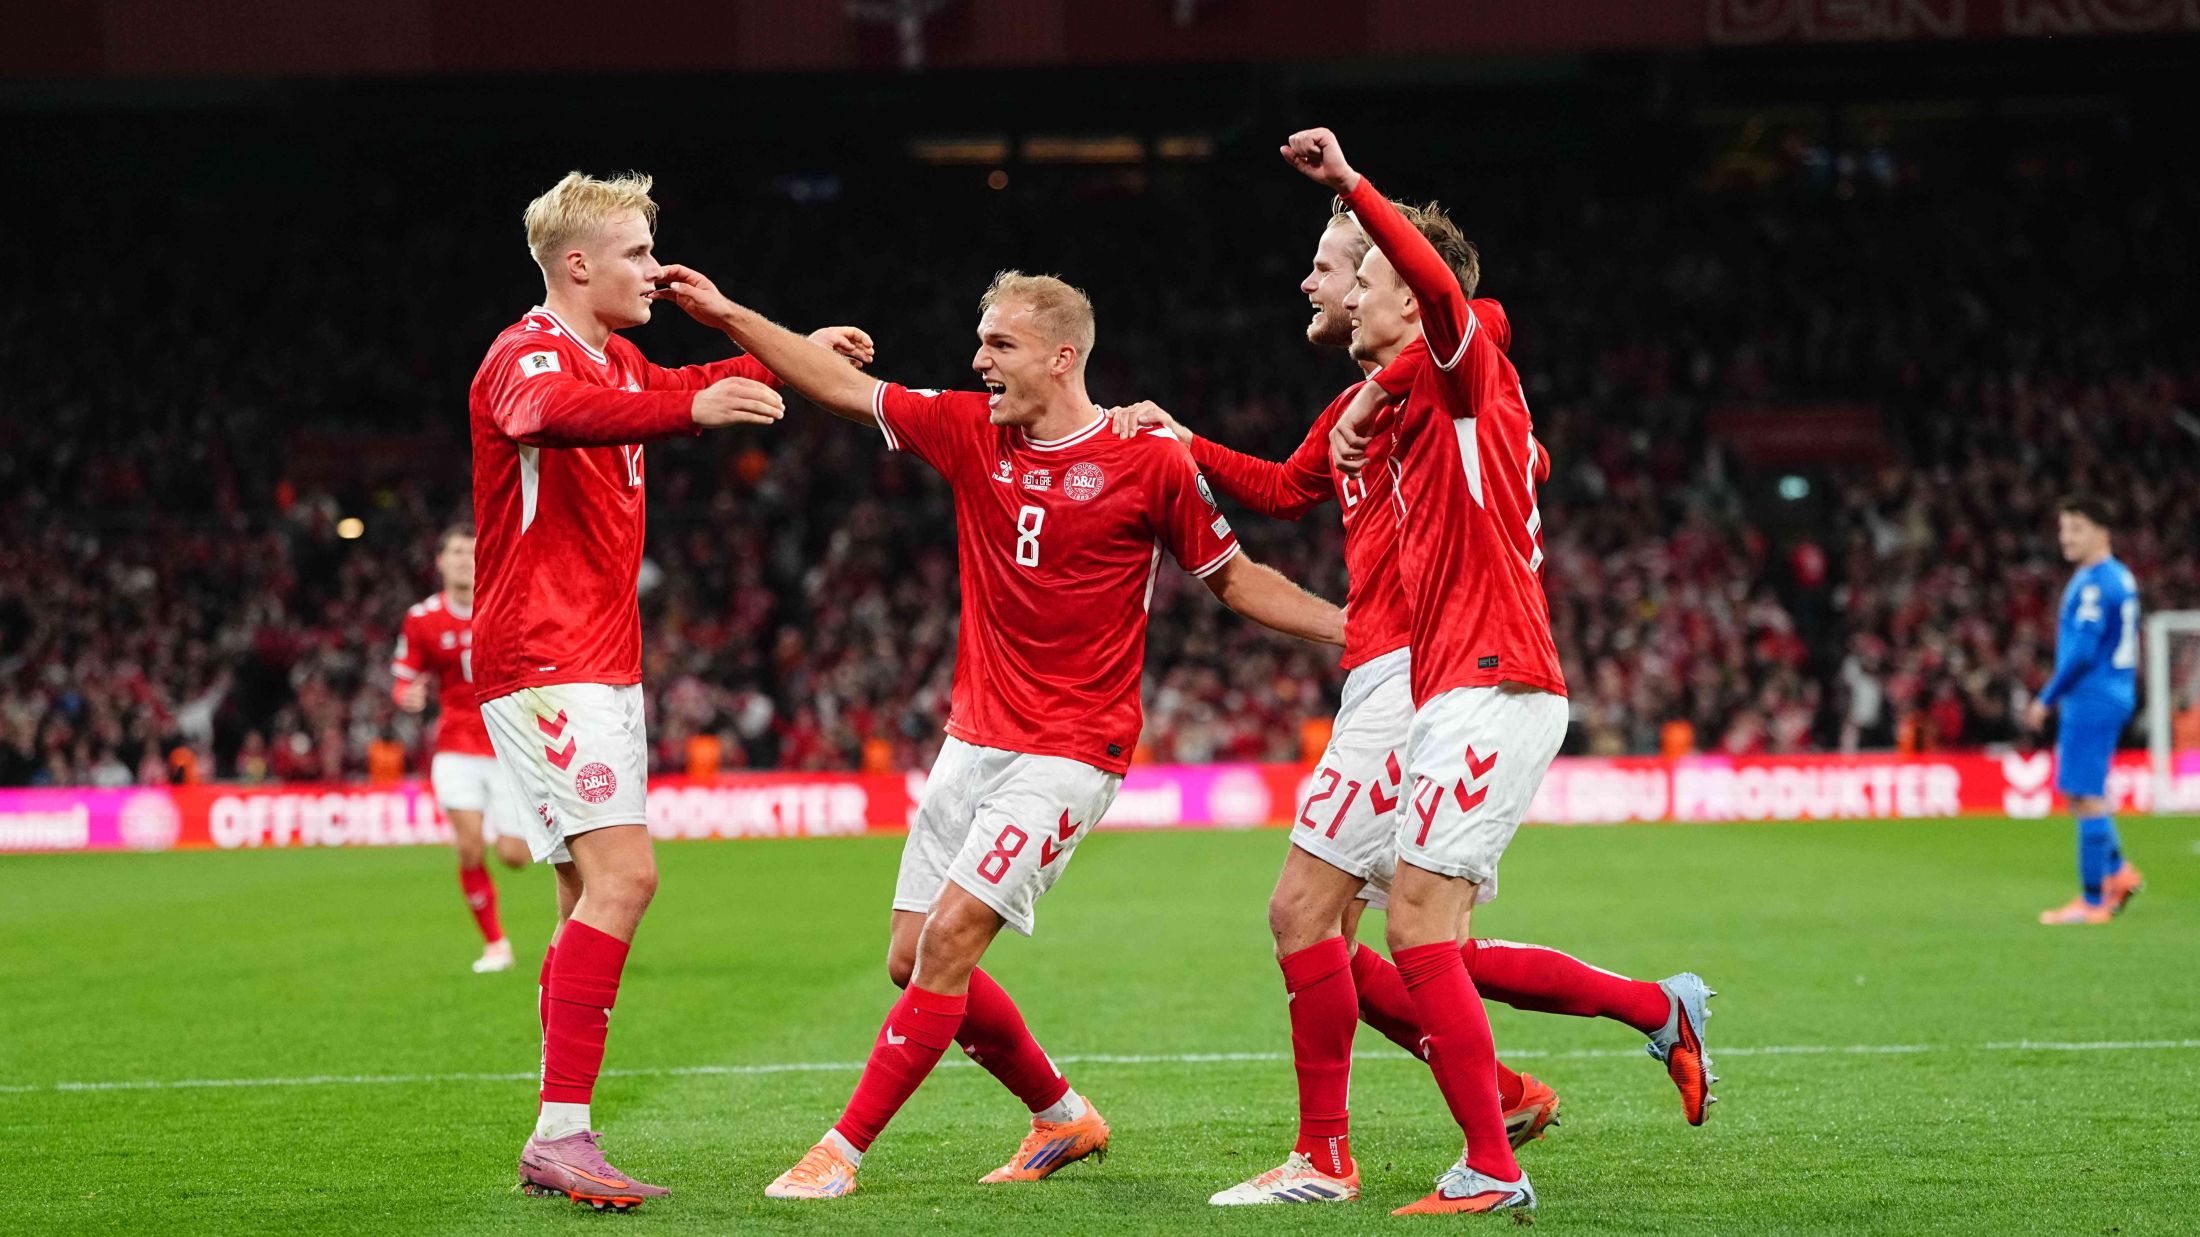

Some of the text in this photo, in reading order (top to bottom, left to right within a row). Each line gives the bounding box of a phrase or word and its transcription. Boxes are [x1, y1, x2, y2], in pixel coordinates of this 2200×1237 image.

[1072, 475, 1096, 488] DBU
[1015, 504, 1046, 568] 8
[583, 775, 609, 791] DBU
[1299, 767, 1362, 840] 21
[1674, 764, 1961, 821] PRODUKTER
[209, 783, 868, 848] OFFICIELL ODUKTER
[976, 824, 1029, 885] 8
